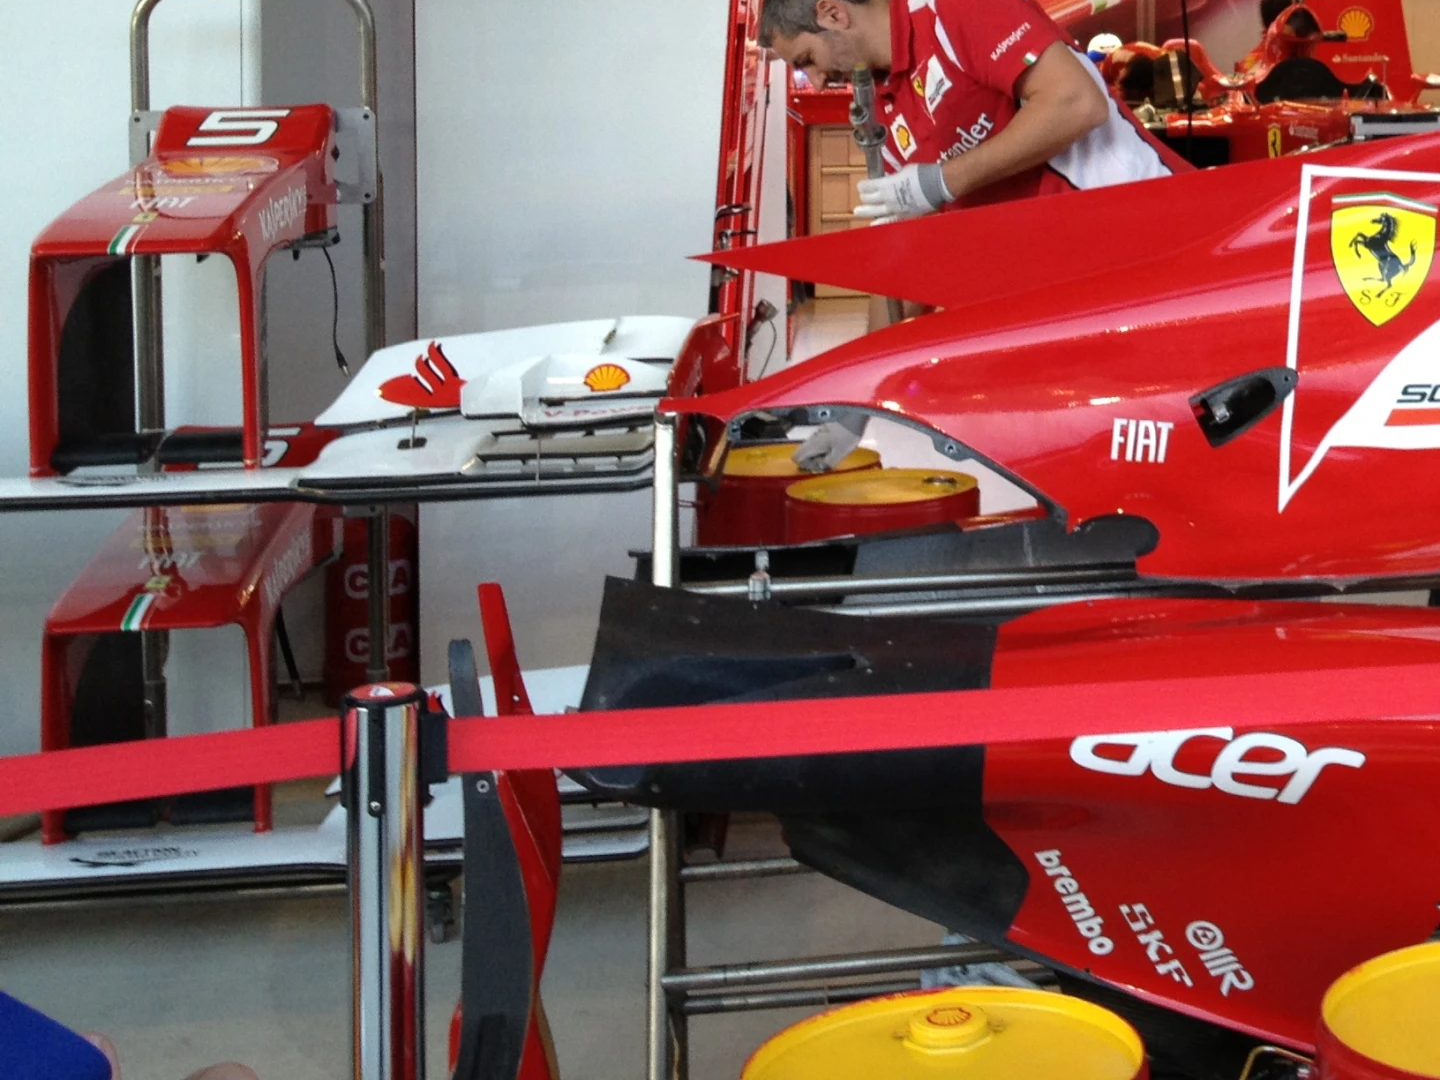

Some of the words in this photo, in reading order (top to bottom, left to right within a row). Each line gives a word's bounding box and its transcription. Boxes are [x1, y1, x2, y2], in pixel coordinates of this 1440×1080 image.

[185, 108, 293, 148] 5
[1110, 417, 1174, 464] FIAT
[1069, 725, 1367, 806] acer
[1034, 848, 1115, 956] brembo
[1118, 902, 1195, 988] SKF
